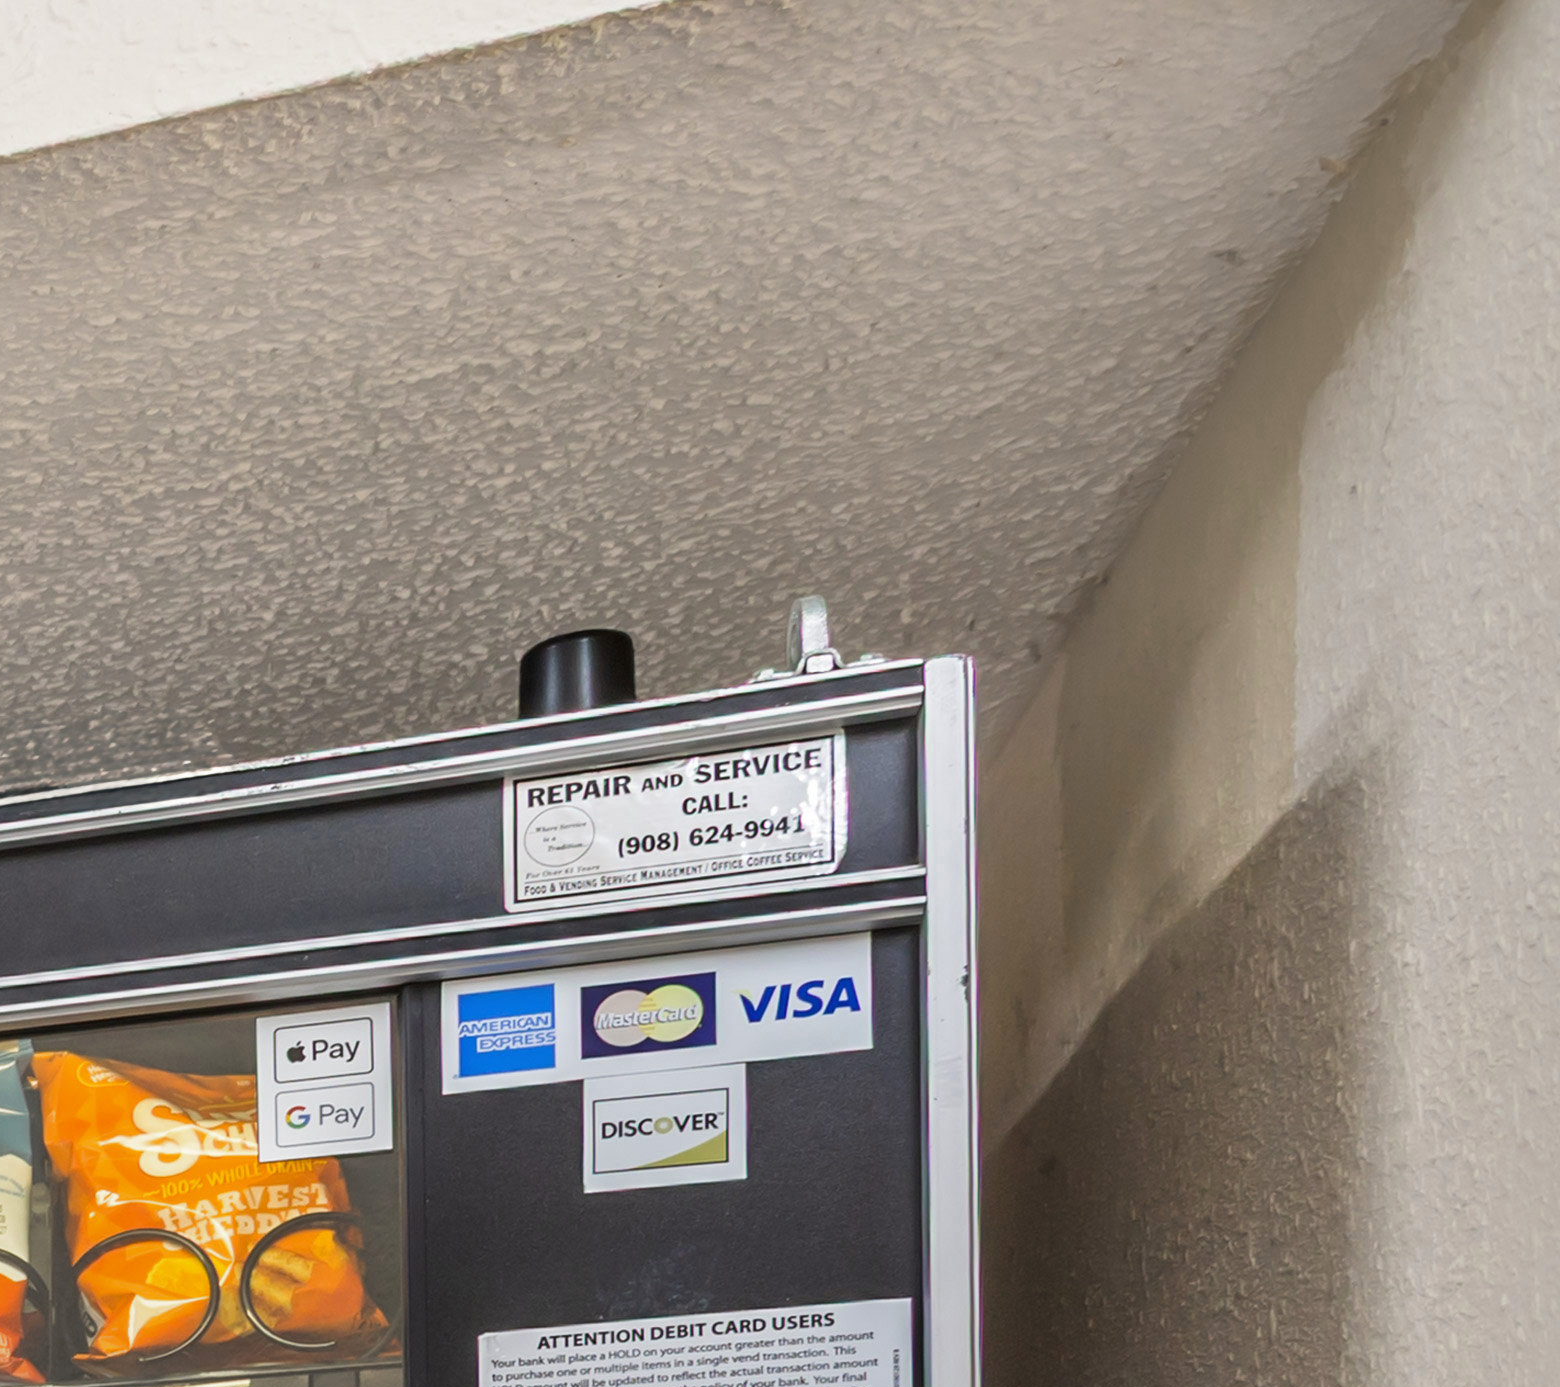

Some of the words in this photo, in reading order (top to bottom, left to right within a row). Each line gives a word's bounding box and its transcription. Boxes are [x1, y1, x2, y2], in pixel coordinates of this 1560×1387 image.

[527, 775, 631, 808] REPAIR
[641, 773, 683, 792] AND
[693, 748, 822, 784] SERVICE
[681, 792, 749, 816] CALL:
[617, 830, 680, 858] (908)
[689, 814, 806, 847] 624-9941
[733, 977, 861, 1023] VISA
[458, 1014, 550, 1035] AMERICAN
[595, 1003, 698, 1030] MasterCard
[310, 1038, 361, 1064] Pay
[478, 1032, 556, 1051] EXPRESS
[318, 1102, 365, 1131] Pay
[601, 1111, 719, 1140] DISCOVER
[537, 1327, 645, 1351] ATTENTION
[650, 1323, 707, 1343] DEBIT
[711, 1317, 767, 1337] CARD
[771, 1312, 836, 1332] USERS
